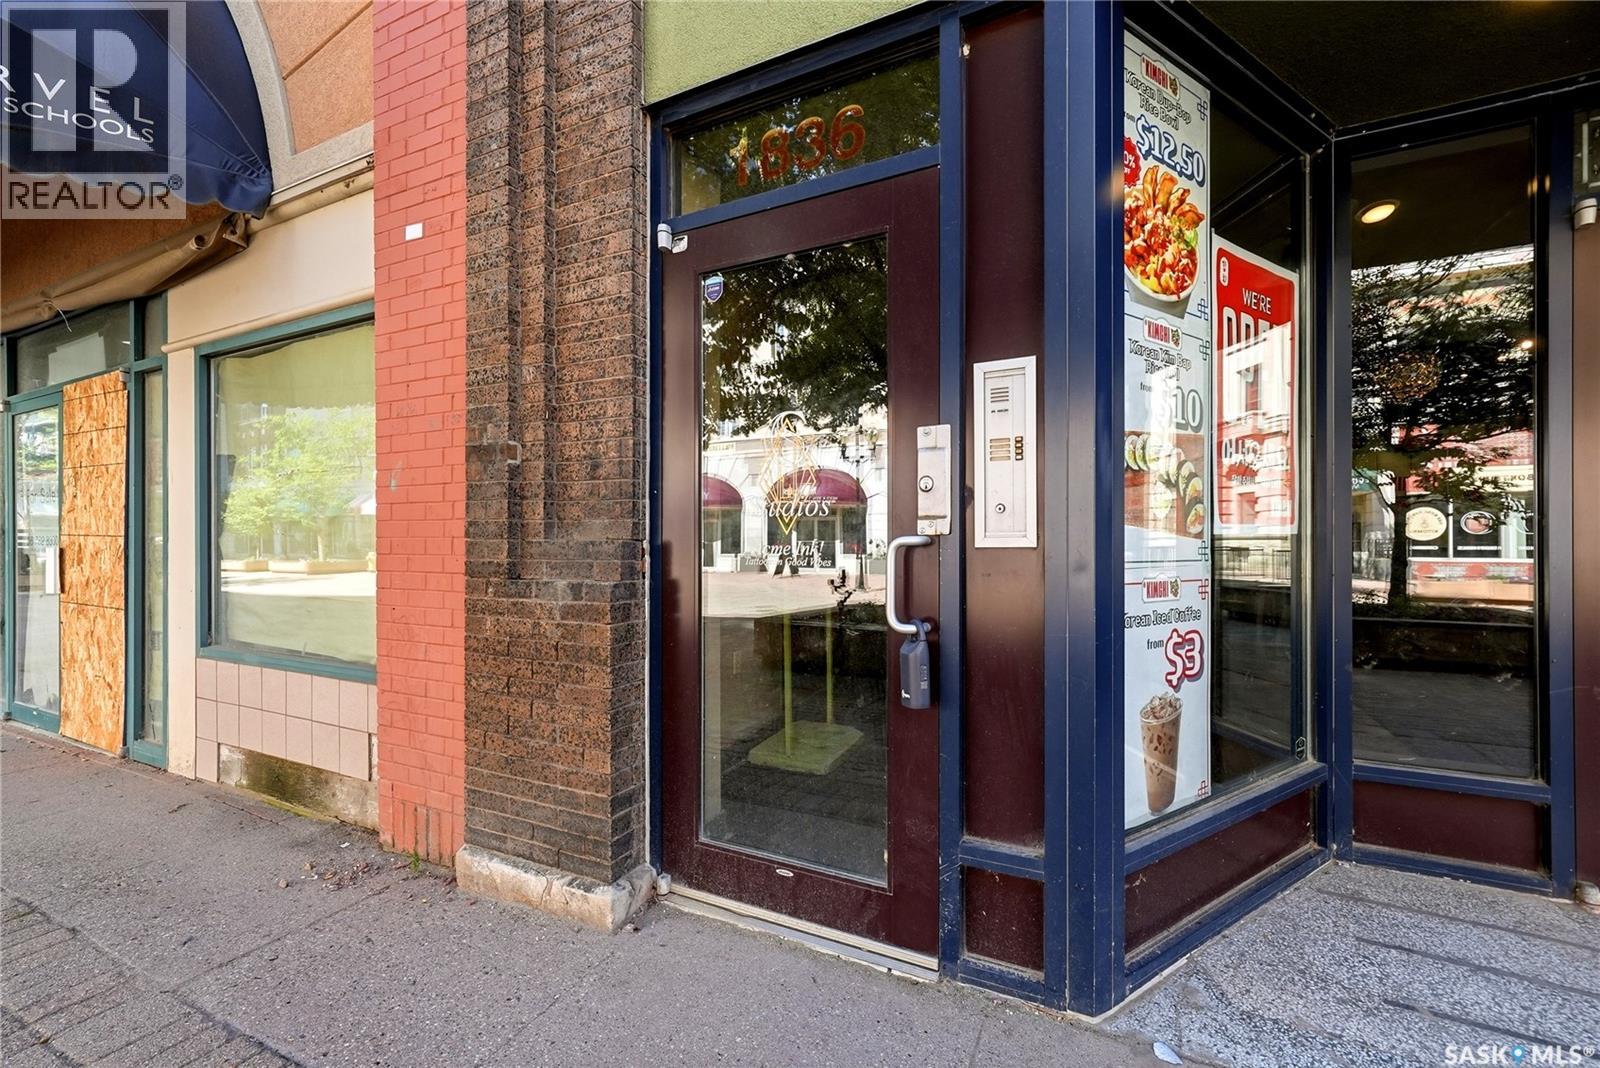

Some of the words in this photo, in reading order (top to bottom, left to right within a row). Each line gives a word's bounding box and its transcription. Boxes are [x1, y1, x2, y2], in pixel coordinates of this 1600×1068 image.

[1125, 68, 1157, 101] Korean
[4, 96, 154, 144] SCHOOLS
[1139, 92, 1159, 118] Rice
[1160, 107, 1179, 131] Bowl
[729, 104, 866, 187] 1836
[1136, 114, 1205, 188] $12.50
[1242, 288, 1271, 315] WE'RE
[1128, 338, 1160, 361] Korean
[1160, 347, 1177, 366] Kim
[1177, 353, 1192, 371] Bap
[1152, 608, 1174, 626] Iced
[1173, 606, 1202, 623] Coffee
[1146, 637, 1165, 650] from
[1165, 628, 1205, 693] $3
